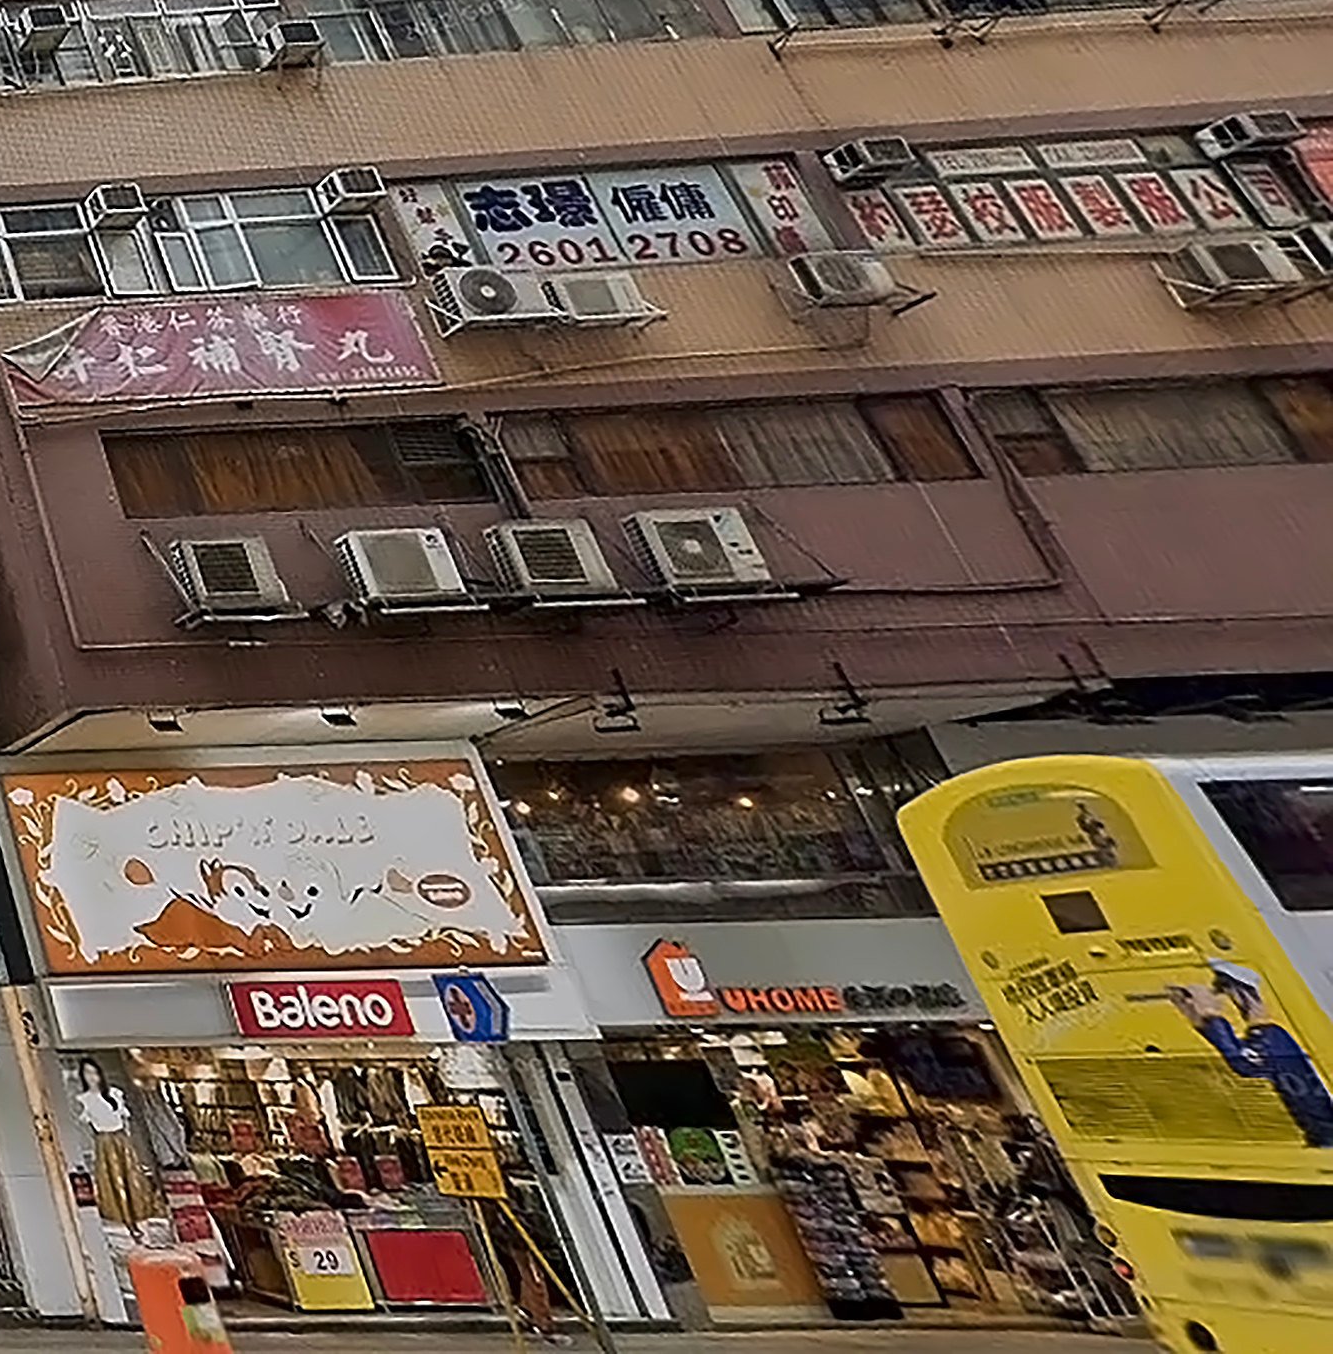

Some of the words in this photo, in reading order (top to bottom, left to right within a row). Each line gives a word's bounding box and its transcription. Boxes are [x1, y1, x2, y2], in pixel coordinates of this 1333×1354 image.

[496, 236, 622, 266] 2601
[635, 227, 748, 260] 2708
[249, 986, 394, 1029] Baleno
